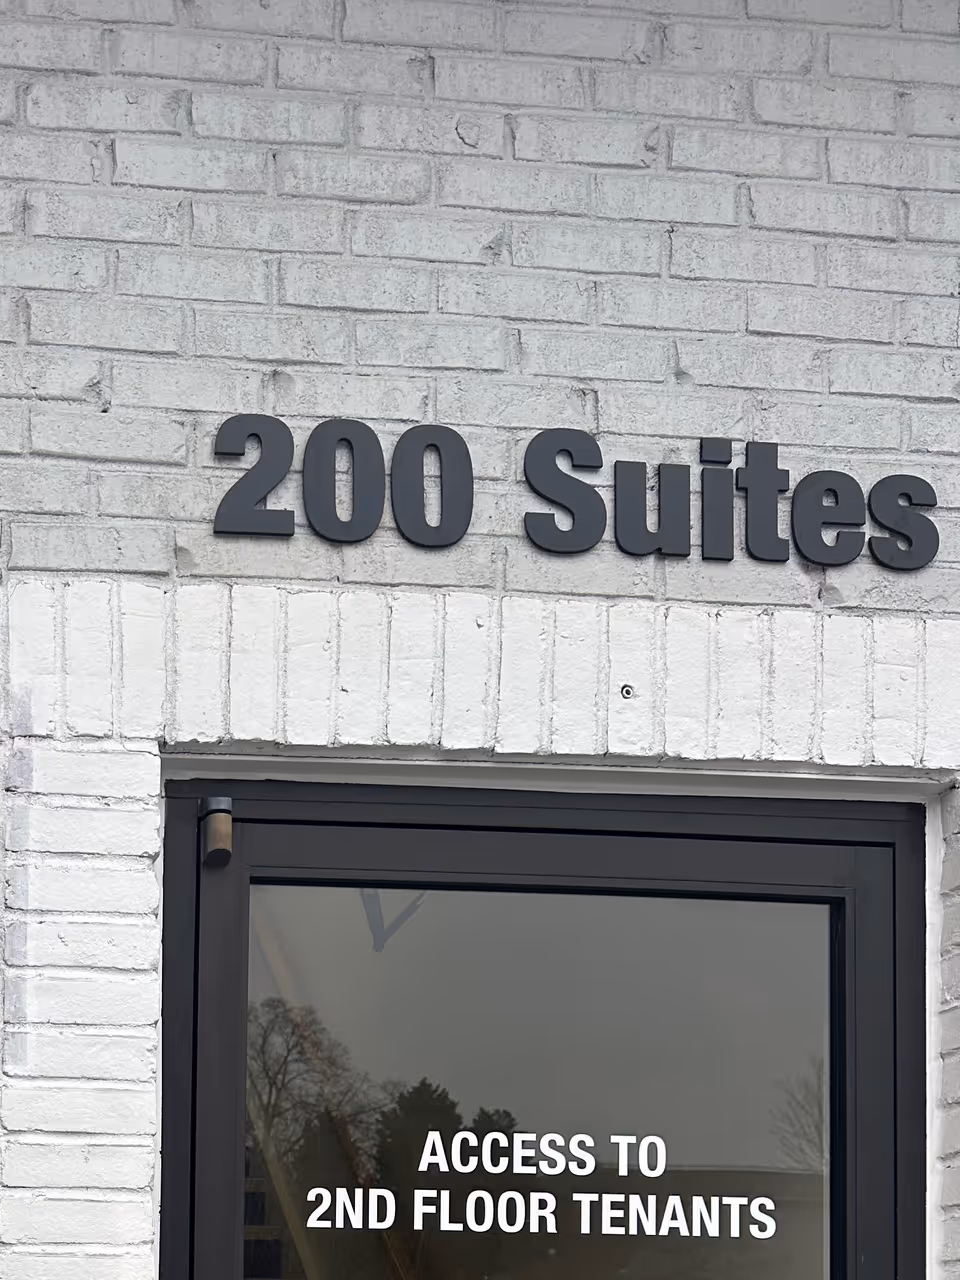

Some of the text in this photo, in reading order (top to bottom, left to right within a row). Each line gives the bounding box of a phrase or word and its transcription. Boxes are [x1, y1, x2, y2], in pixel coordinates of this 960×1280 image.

[213, 412, 941, 571] 200 Suites
[418, 1131, 666, 1177] ACCESS TO
[307, 1188, 776, 1238] 2ND FLOOR TENANTS
